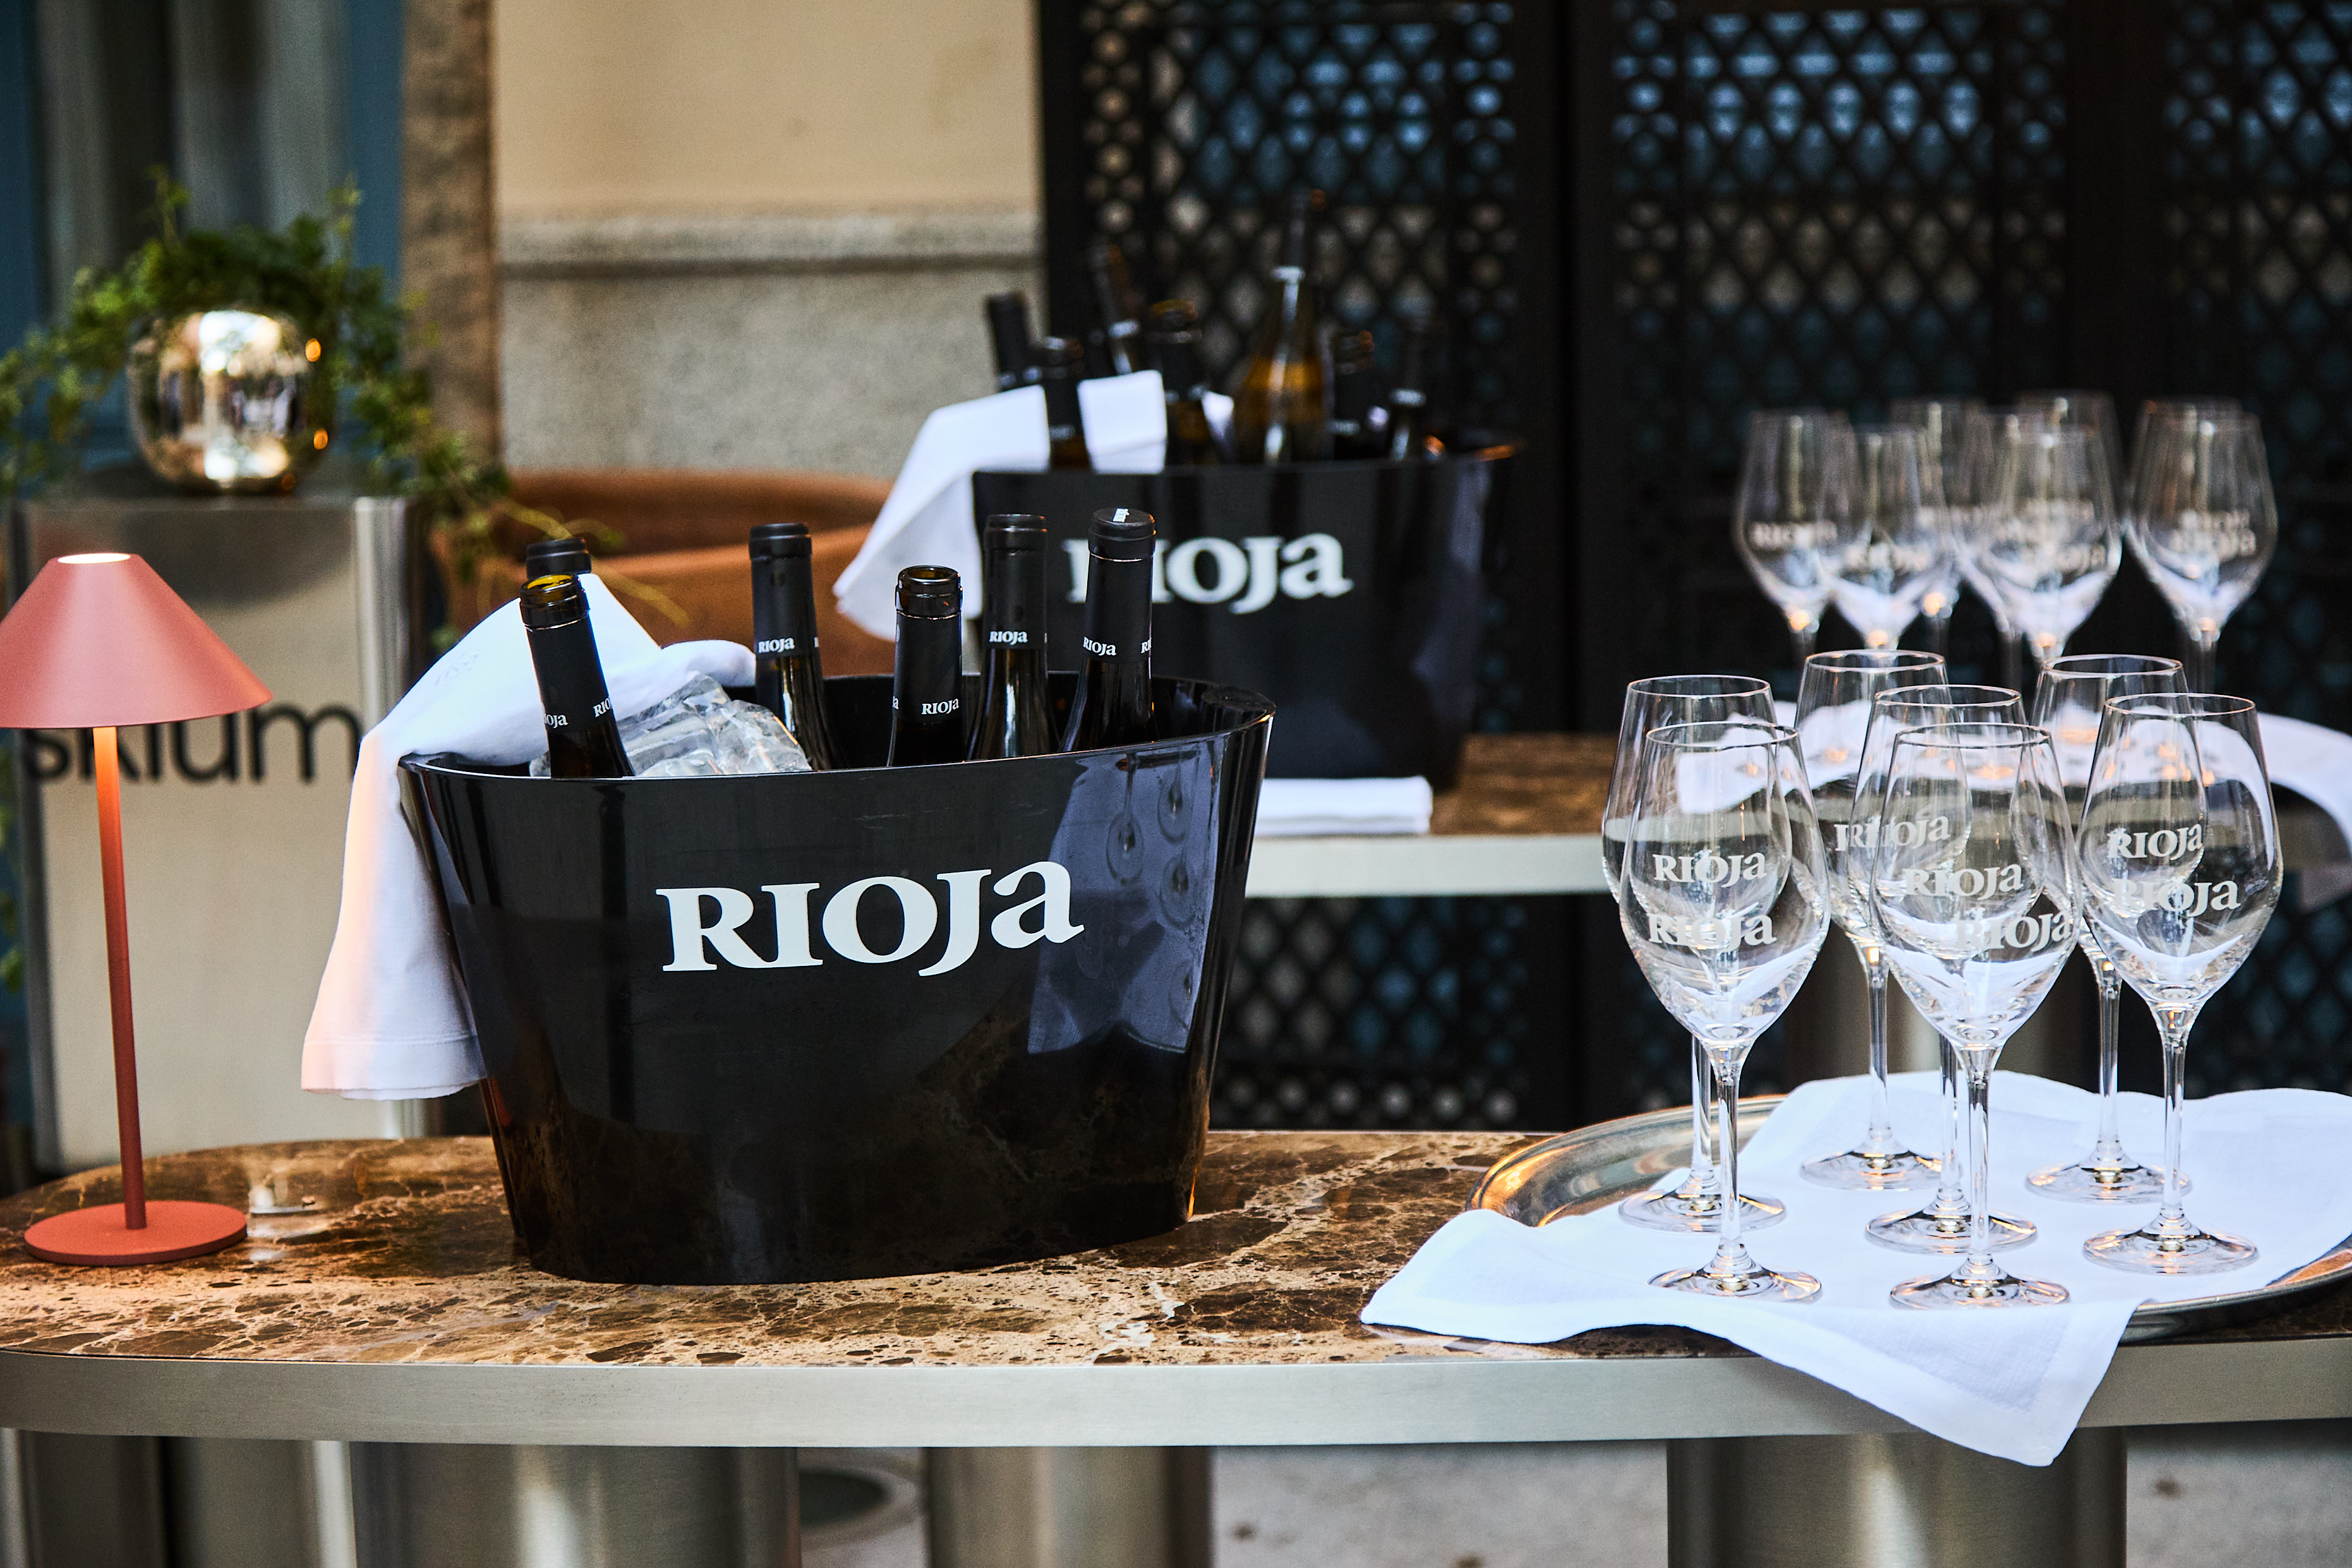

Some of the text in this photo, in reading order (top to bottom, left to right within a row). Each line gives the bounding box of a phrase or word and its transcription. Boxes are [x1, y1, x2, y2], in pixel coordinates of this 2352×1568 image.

[758, 637, 795, 653] RIOJa
[989, 630, 1028, 645] RIOJa
[1083, 636, 1116, 656] RIOJa
[921, 698, 959, 715] RIOJa
[2107, 824, 2204, 860] RIOJa
[1653, 852, 1768, 888] RIOJa
[1903, 864, 2024, 901] RIOJa
[655, 860, 1085, 977] RIOJa
